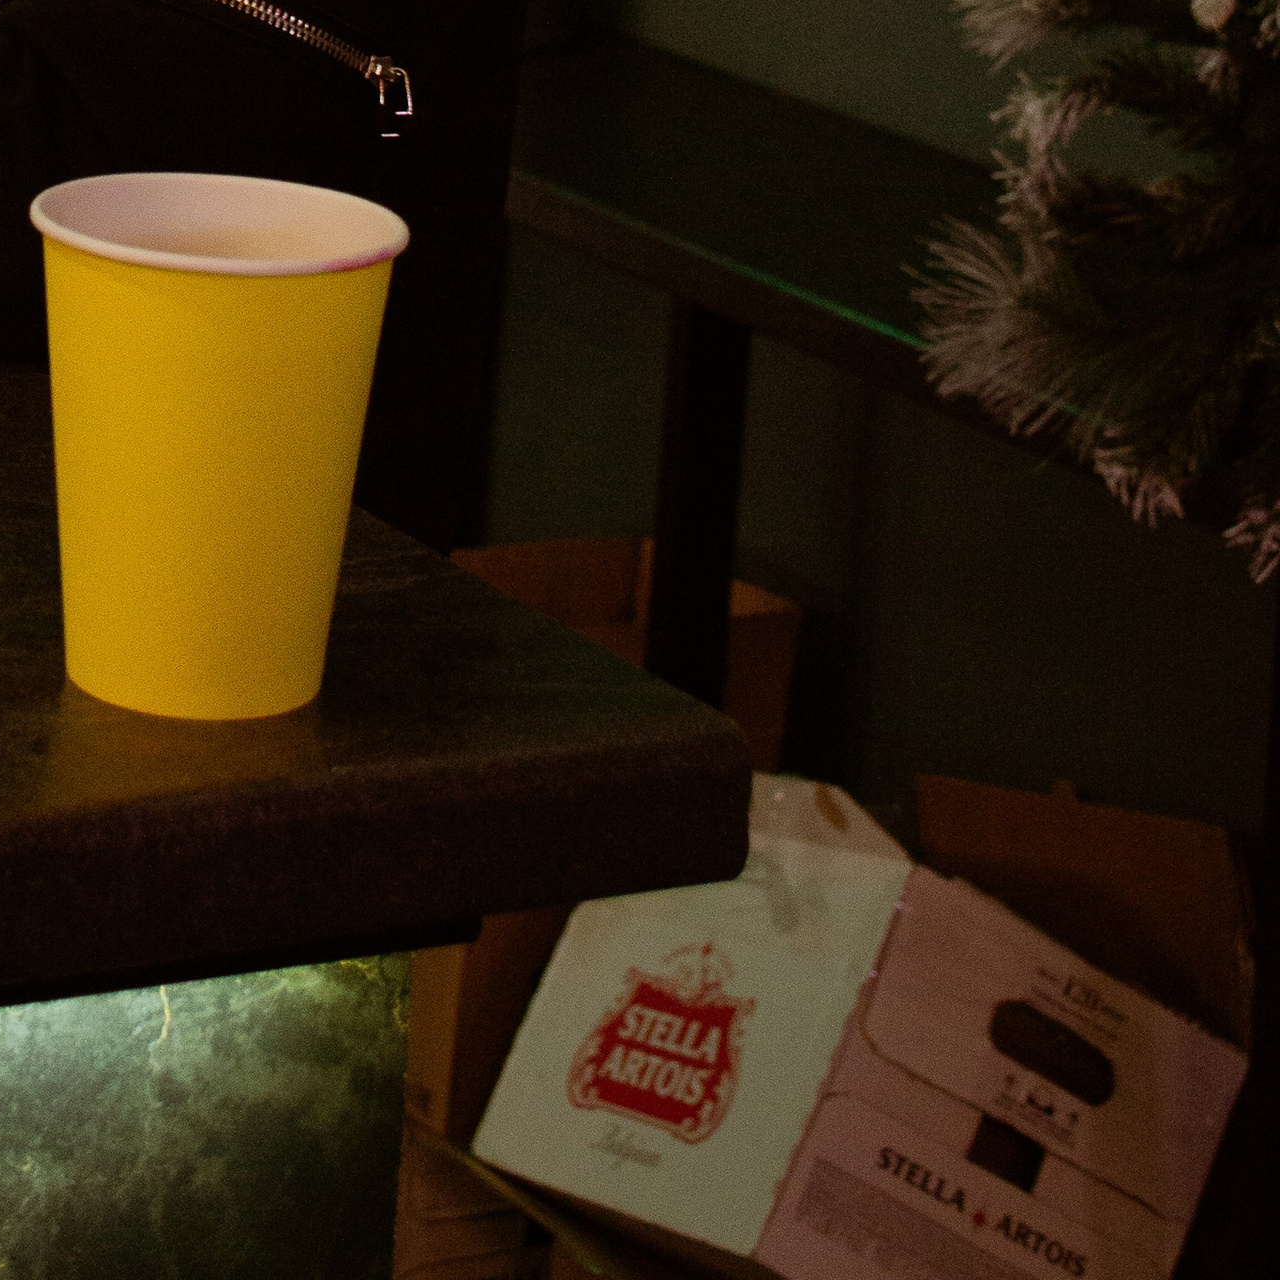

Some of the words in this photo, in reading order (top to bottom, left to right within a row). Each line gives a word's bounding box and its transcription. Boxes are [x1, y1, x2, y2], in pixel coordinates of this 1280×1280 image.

[617, 1003, 722, 1063] STELLA
[597, 1043, 718, 1107] ARTOIS
[877, 1146, 966, 1213] STELLA
[994, 1213, 1087, 1277] ARTOIS
